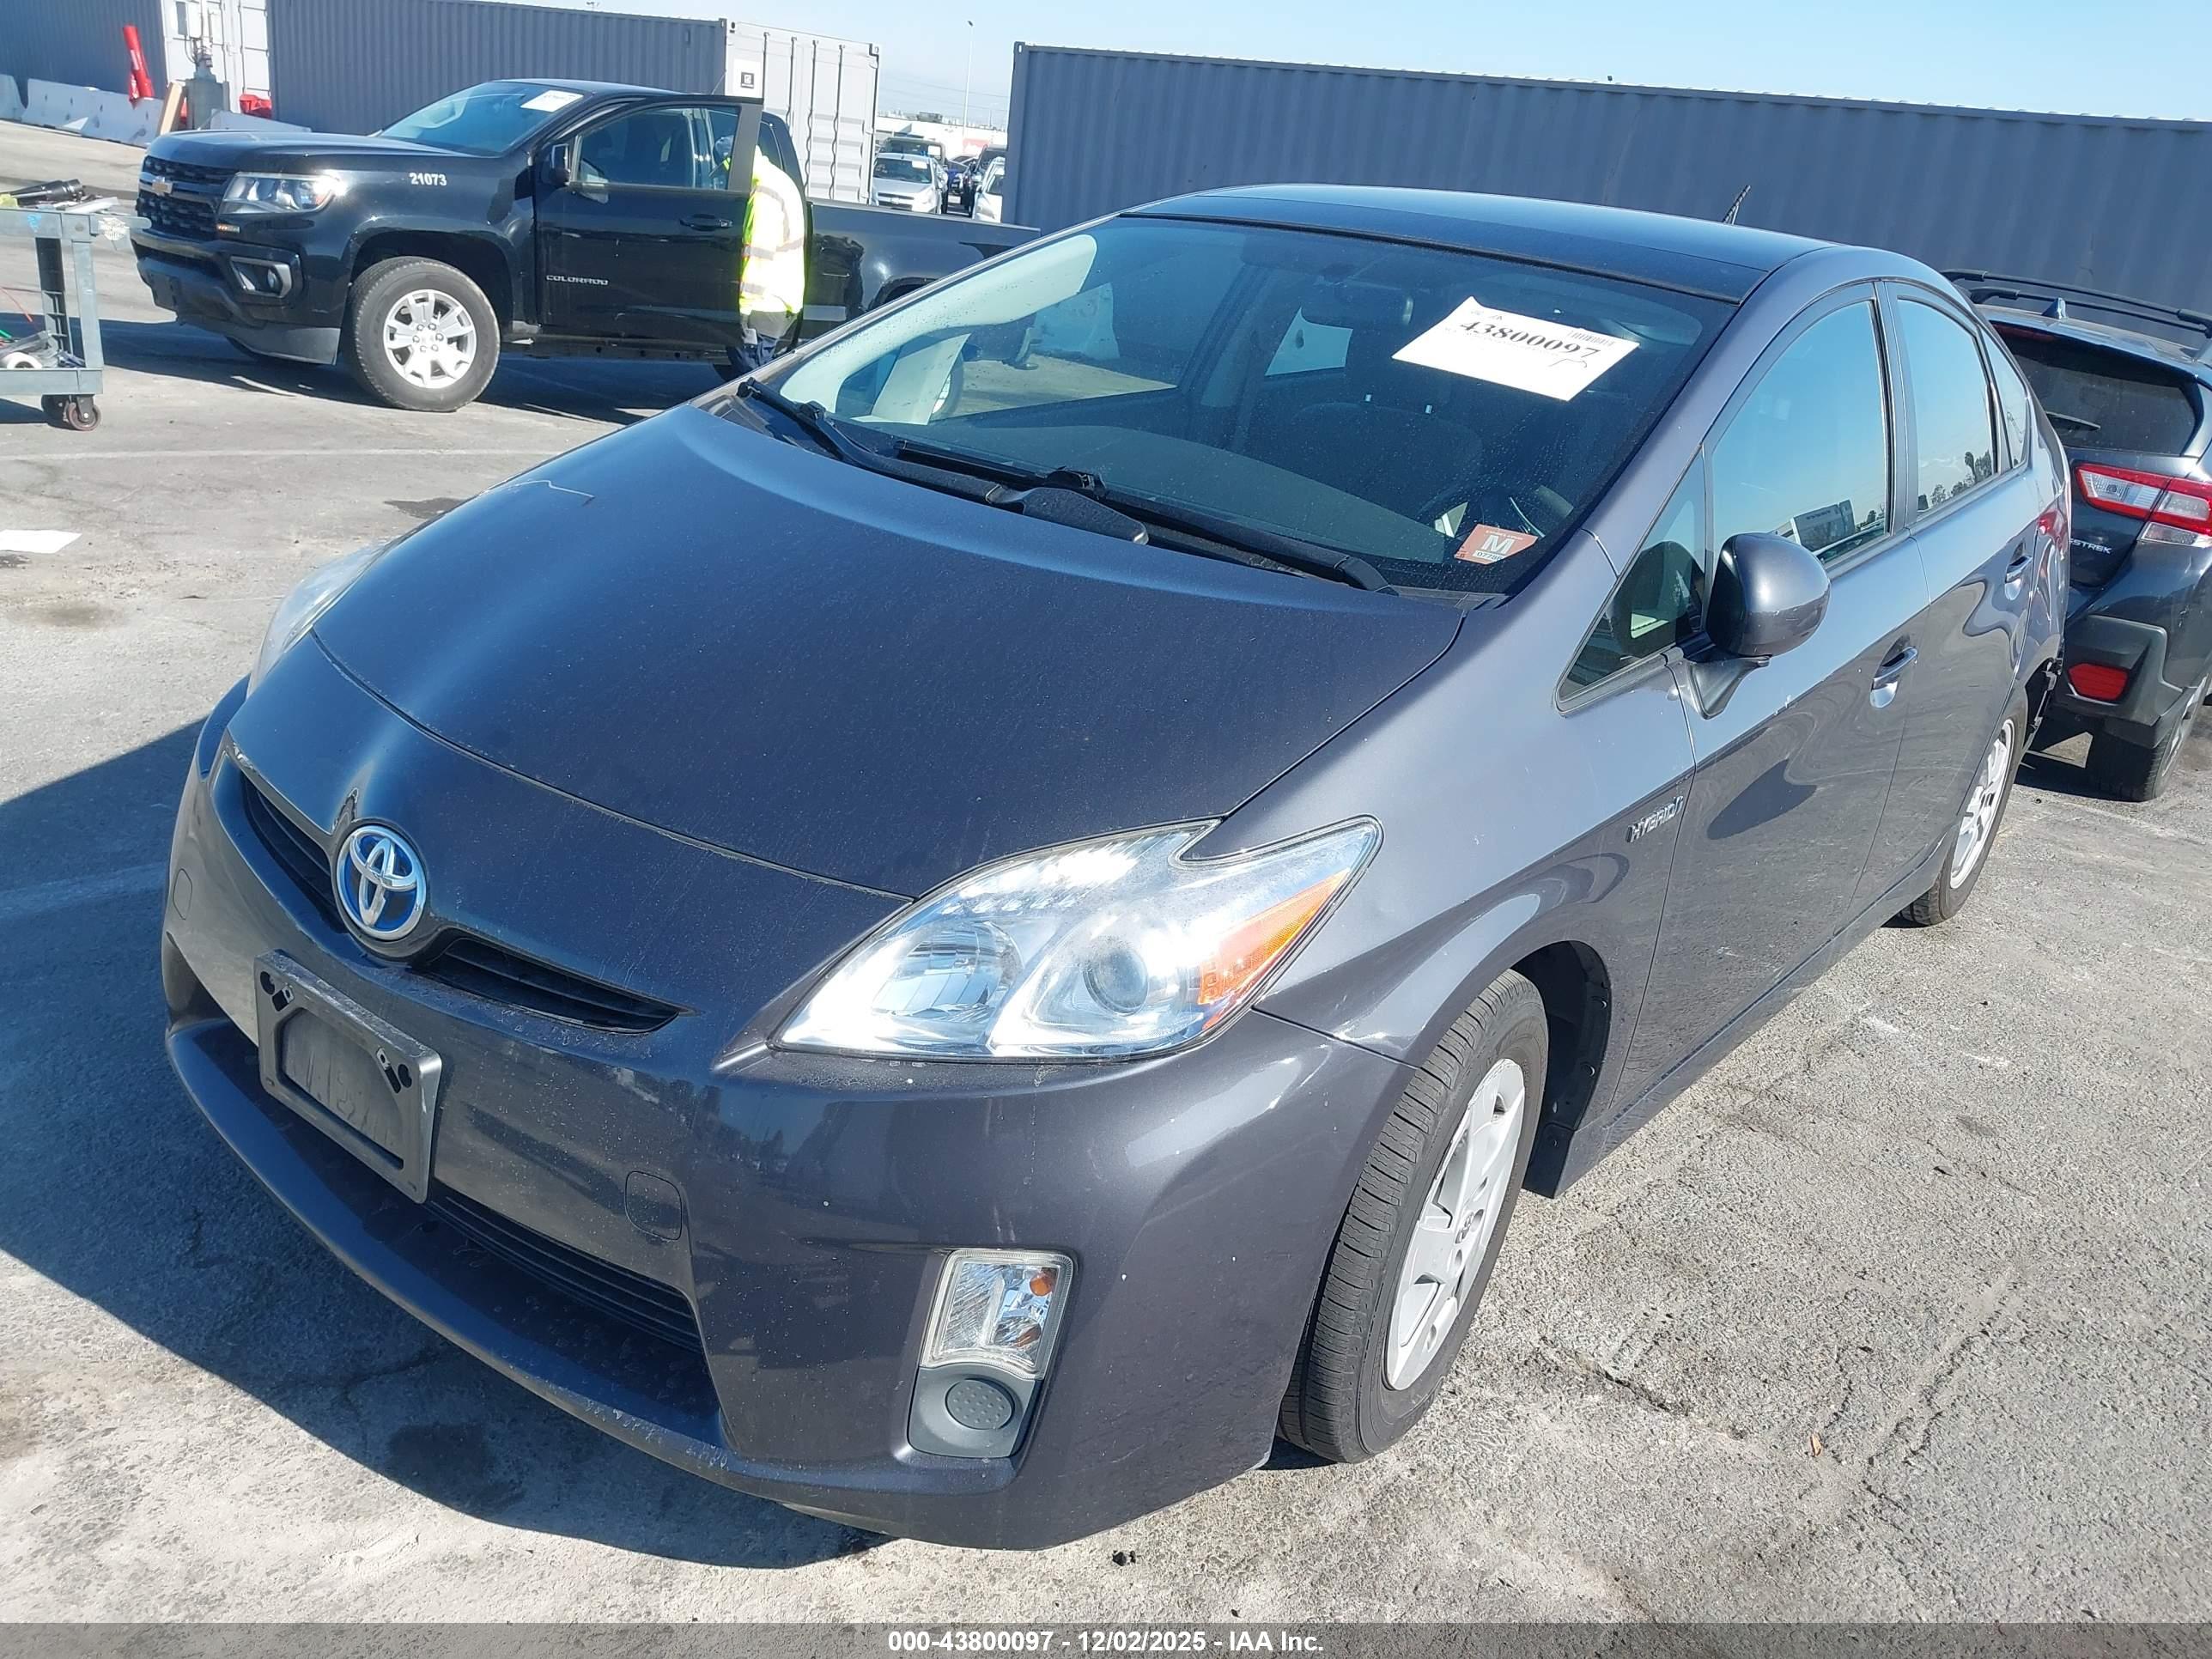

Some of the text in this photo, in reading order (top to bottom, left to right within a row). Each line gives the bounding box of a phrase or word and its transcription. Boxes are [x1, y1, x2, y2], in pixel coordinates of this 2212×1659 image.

[409, 172, 447, 186] 21073
[546, 275, 609, 286] COLORADO
[1460, 320, 1601, 359] 43800097
[1480, 534, 1516, 555] M
[1626, 795, 1684, 843] HYBRID
